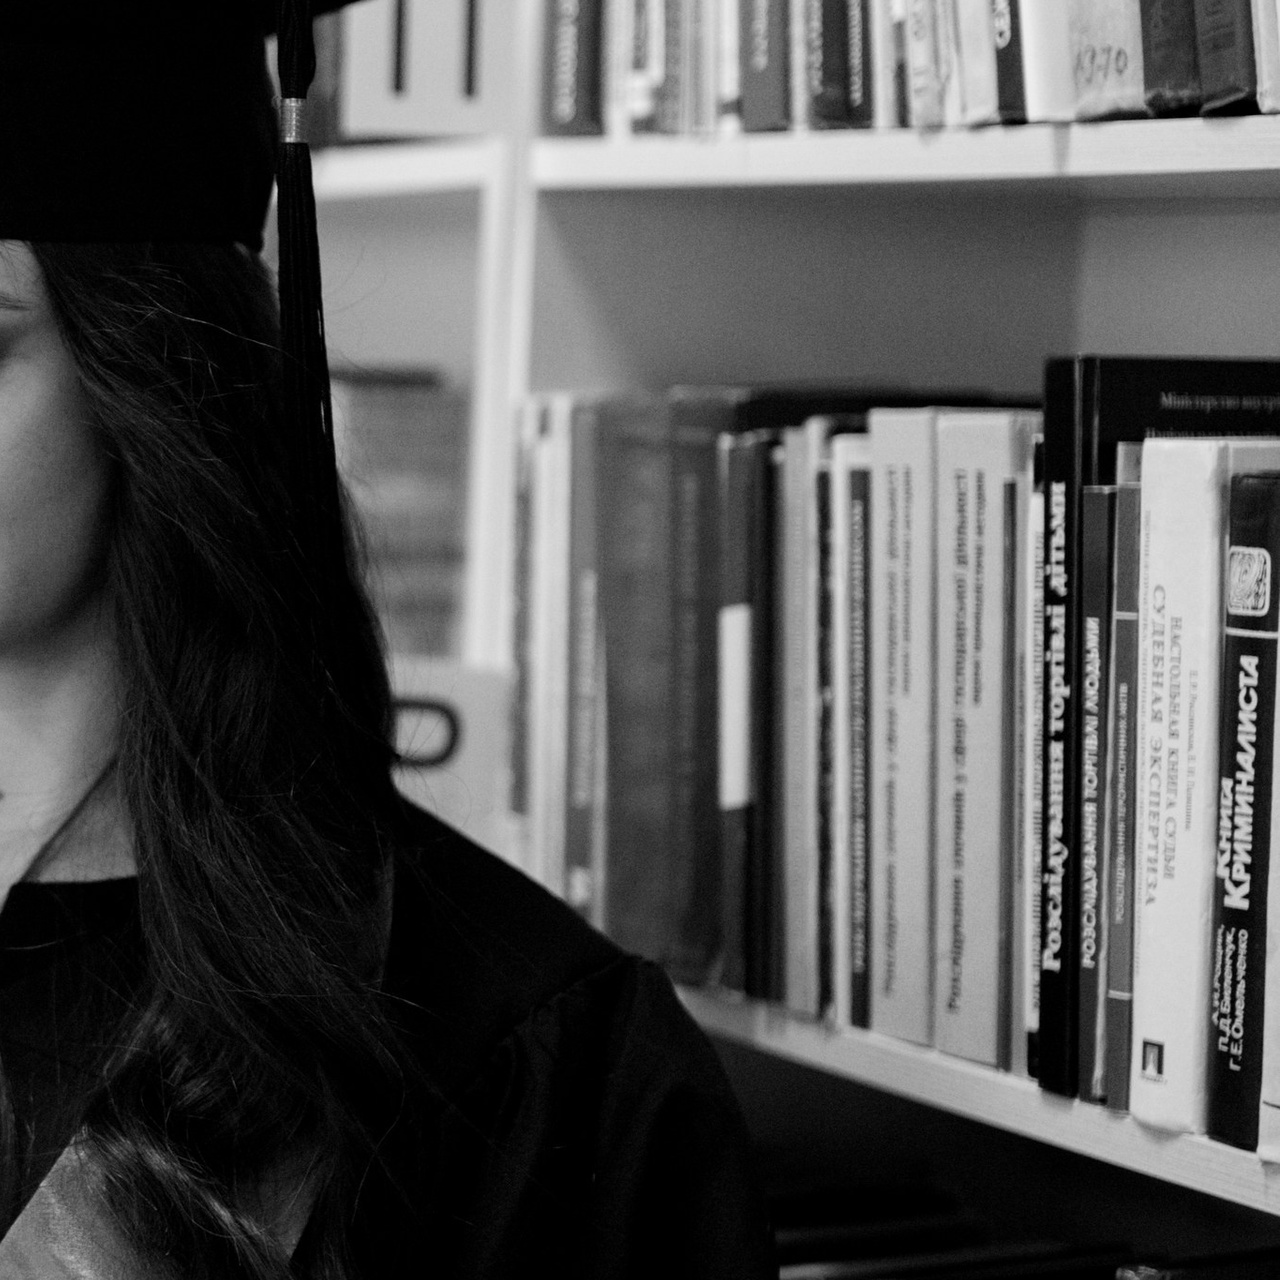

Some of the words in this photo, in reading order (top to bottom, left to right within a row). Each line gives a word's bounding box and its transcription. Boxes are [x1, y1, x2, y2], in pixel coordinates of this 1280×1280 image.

[1043, 481, 1069, 598] дітьми
[1042, 604, 1070, 735] торгівлі
[1085, 617, 1101, 714] ЛЮДЬМИ
[1148, 583, 1167, 723] СУДЕБНАЯ
[1167, 615, 1184, 740] НАСТОЛЬНАЯ
[1083, 716, 1099, 800] ТОРГІВЛІ
[1164, 746, 1180, 810] КНИГА
[1222, 654, 1262, 911] КРИМИНАЛИСТА
[1039, 740, 1068, 973] Розслідування
[1142, 735, 1162, 908] ЭКСПЕРТИЗА
[1162, 814, 1177, 880] СУДЬИ
[1214, 776, 1235, 879] КНИГА
[1079, 802, 1098, 969] РОЗСЛІДУВАННЯ
